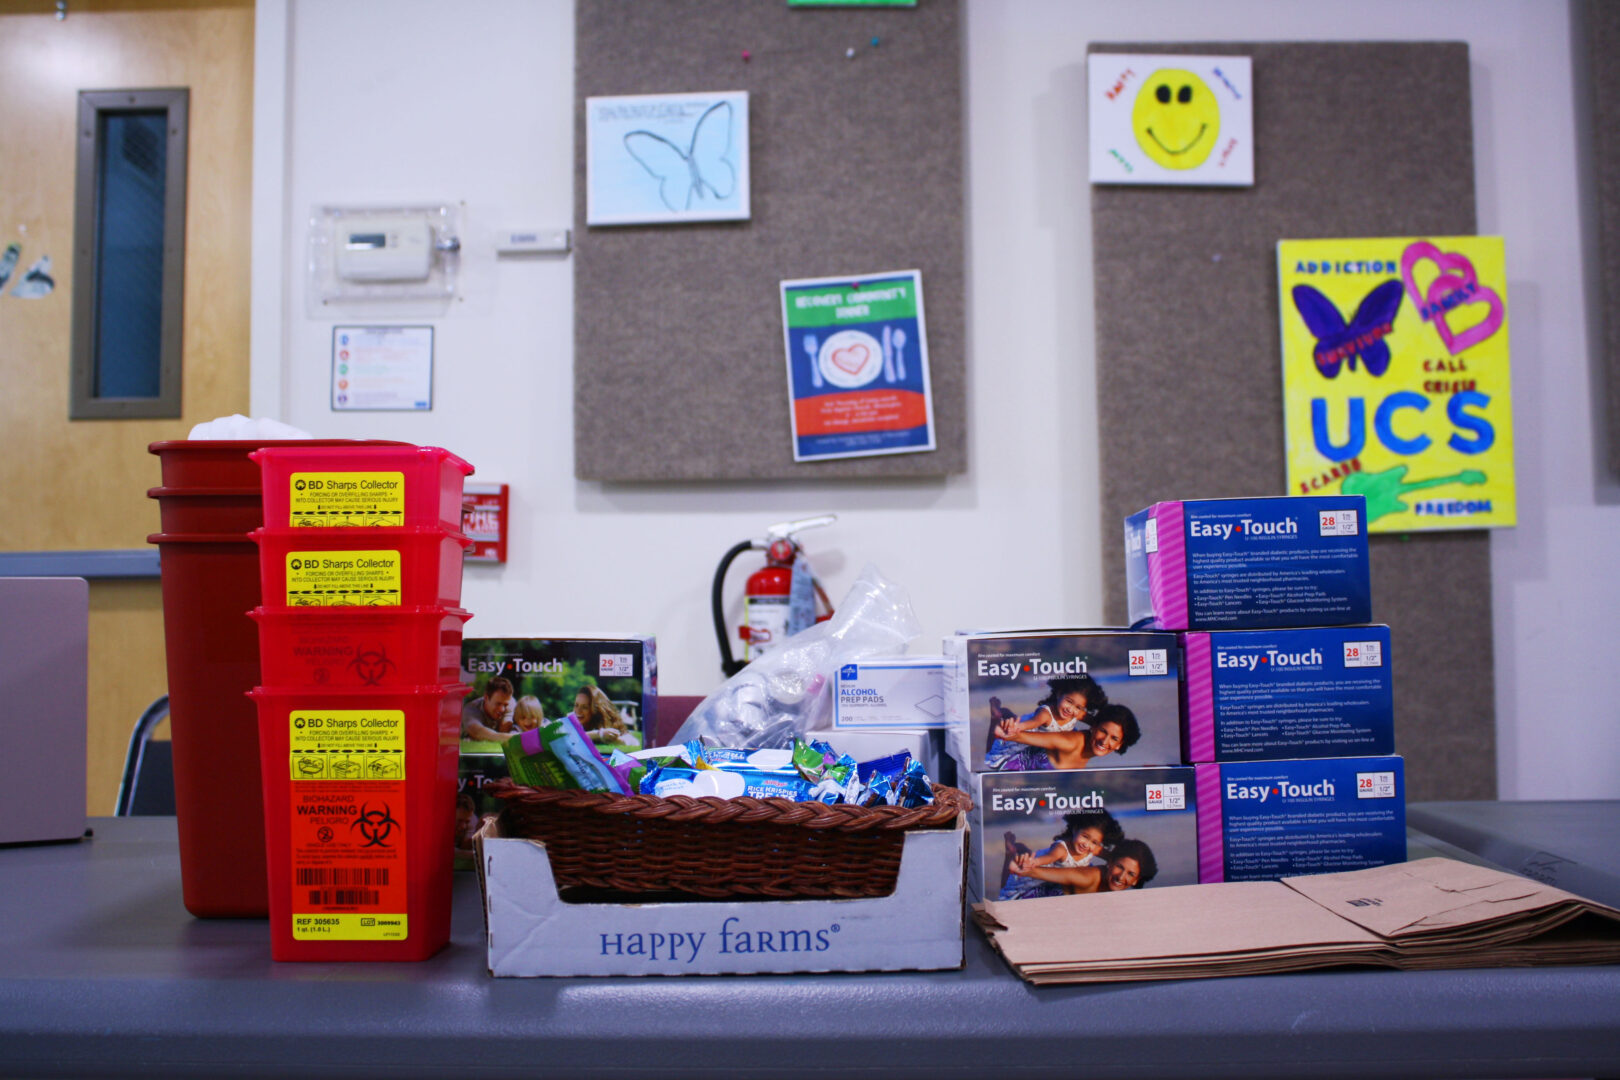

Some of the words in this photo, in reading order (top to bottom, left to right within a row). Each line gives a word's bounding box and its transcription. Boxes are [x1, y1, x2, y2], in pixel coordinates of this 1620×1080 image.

[1296, 261, 1397, 274] ADDICTION
[1423, 359, 1468, 373] CALL
[1310, 390, 1496, 463] UCS
[308, 480, 323, 490] BD
[327, 480, 358, 490] Sharps
[360, 480, 398, 490] Collector
[1414, 498, 1492, 516] FREEDOM
[1322, 516, 1335, 526] 28
[1190, 521, 1233, 540] Easy
[304, 560, 319, 568] BD
[322, 559, 353, 570] Sharps
[356, 559, 394, 568] Collector
[1346, 648, 1359, 657] 28
[1131, 656, 1144, 665] 28
[1217, 652, 1259, 671] Easy
[468, 658, 506, 676] Easy
[977, 660, 1021, 680] Easy
[308, 719, 323, 728] BD
[326, 718, 358, 729] Sharps
[360, 718, 399, 728] Collector
[1360, 779, 1372, 788] 28
[765, 786, 798, 796] KRISPIES
[1148, 790, 1162, 799] 28
[1227, 784, 1270, 803] Easy
[296, 805, 358, 815] WARNING
[992, 794, 1037, 815] Easy
